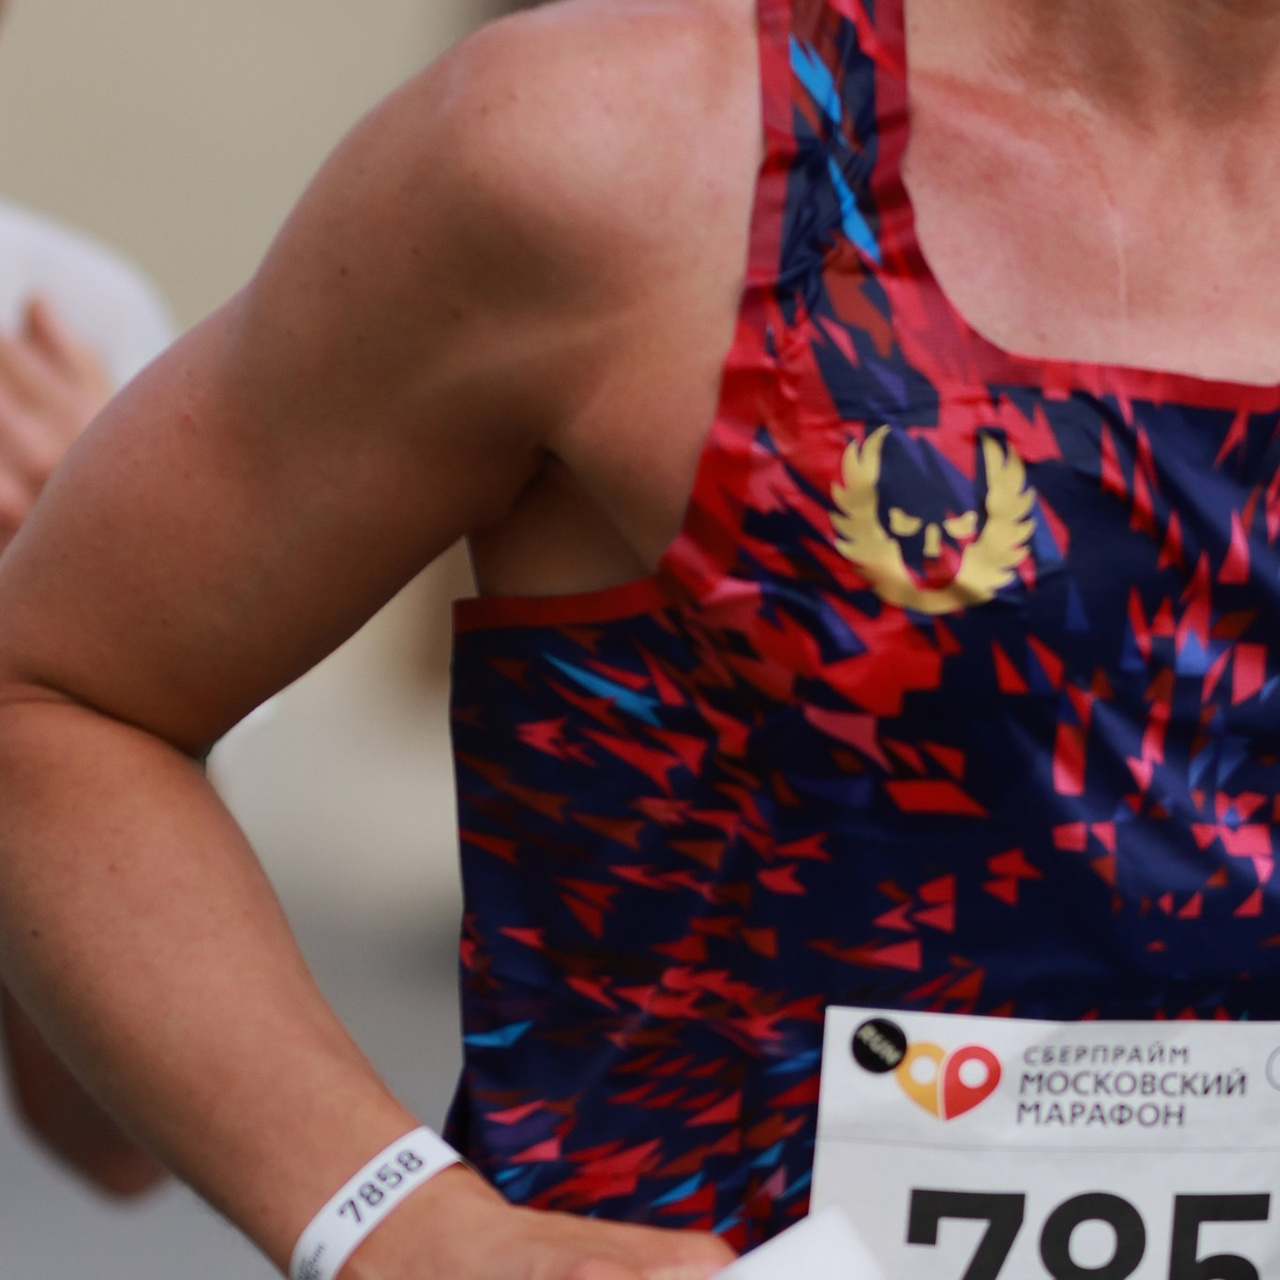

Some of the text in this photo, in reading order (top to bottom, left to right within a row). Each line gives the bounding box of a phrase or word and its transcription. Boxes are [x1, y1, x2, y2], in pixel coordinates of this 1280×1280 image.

[1023, 1042, 1190, 1066] СБЕРПРАЙМ
[1019, 1068, 1247, 1097] МОСКОВСКИЙ
[1016, 1101, 1186, 1127] МАРАФОН
[337, 1150, 424, 1224] 7858
